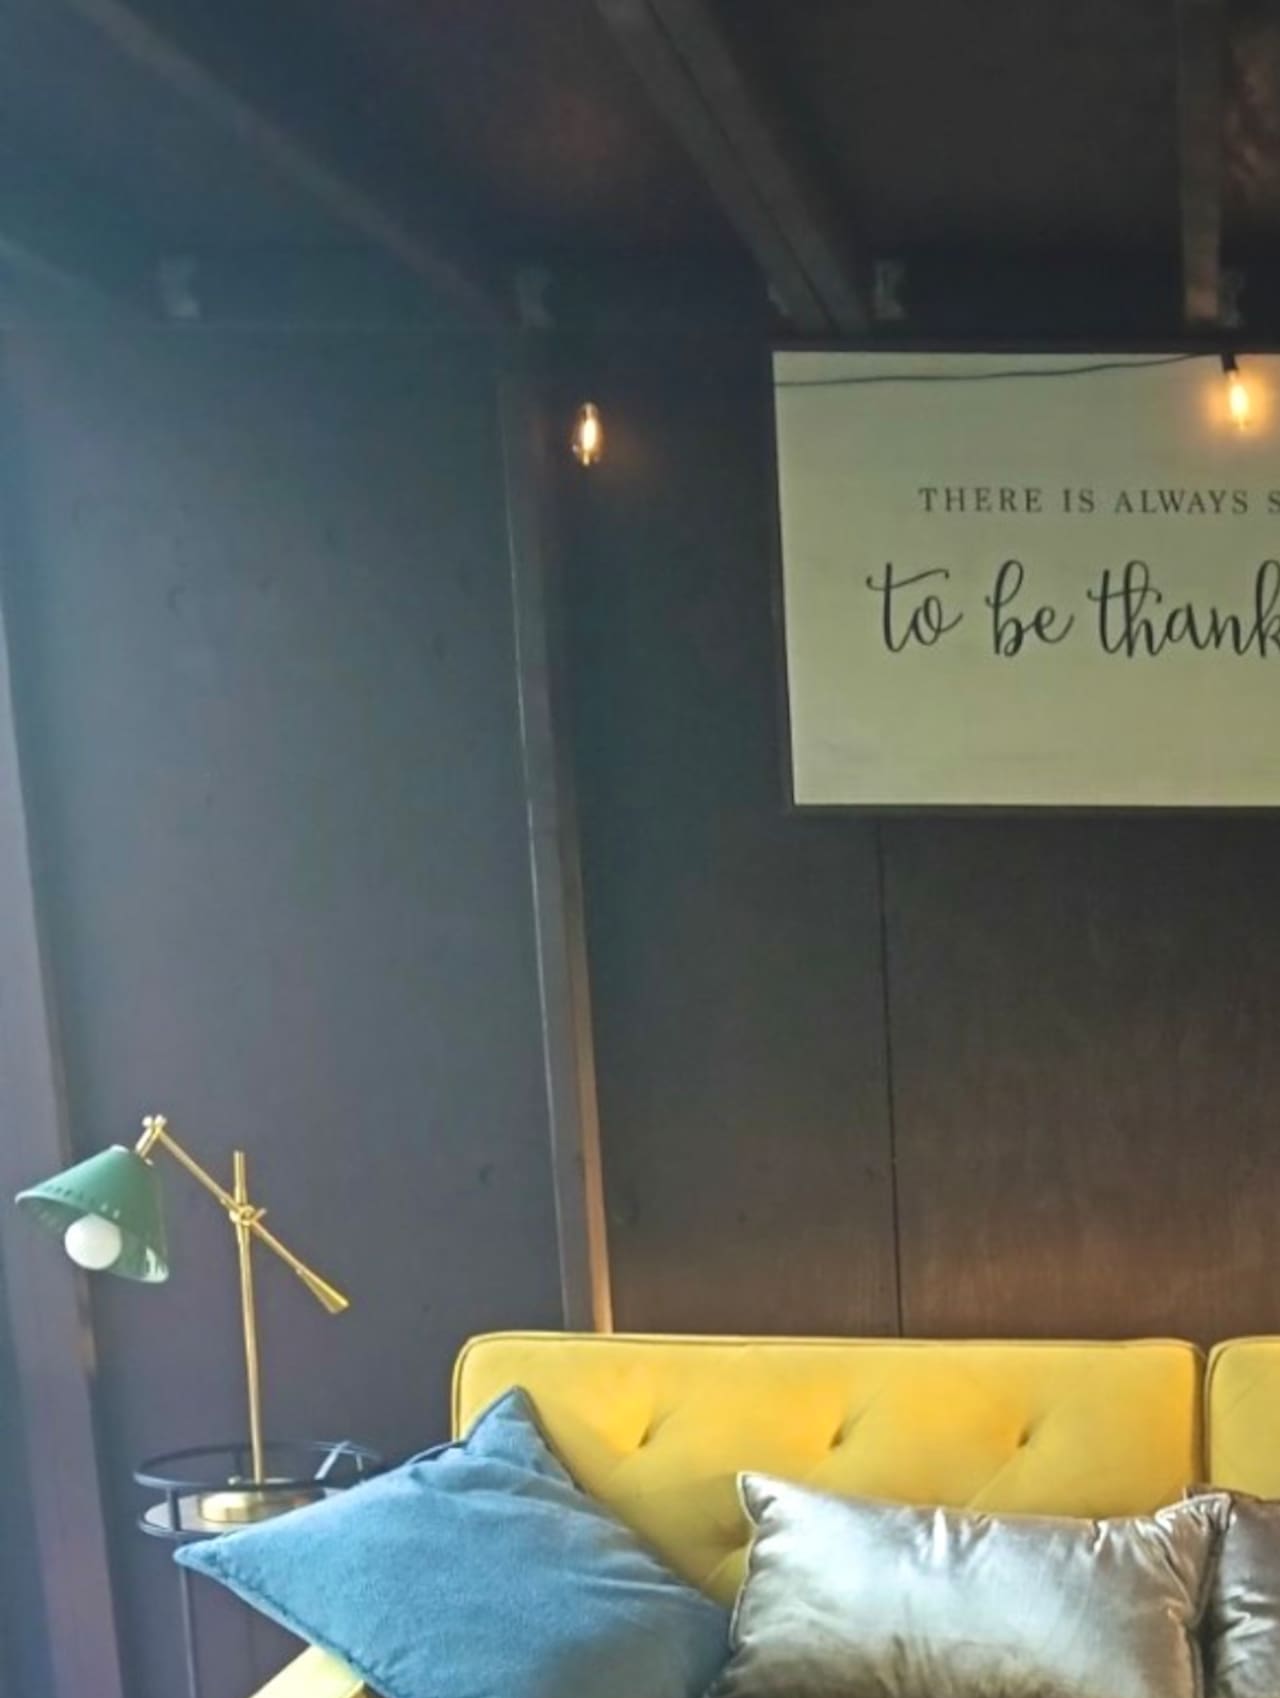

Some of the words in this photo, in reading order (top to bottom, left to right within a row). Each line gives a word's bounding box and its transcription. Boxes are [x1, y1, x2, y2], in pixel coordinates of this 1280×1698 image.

[917, 485, 1043, 514] THERE
[1061, 486, 1096, 515] IS
[1112, 487, 1250, 516] ALWAYS
[864, 561, 965, 655] to
[983, 558, 1075, 658] be
